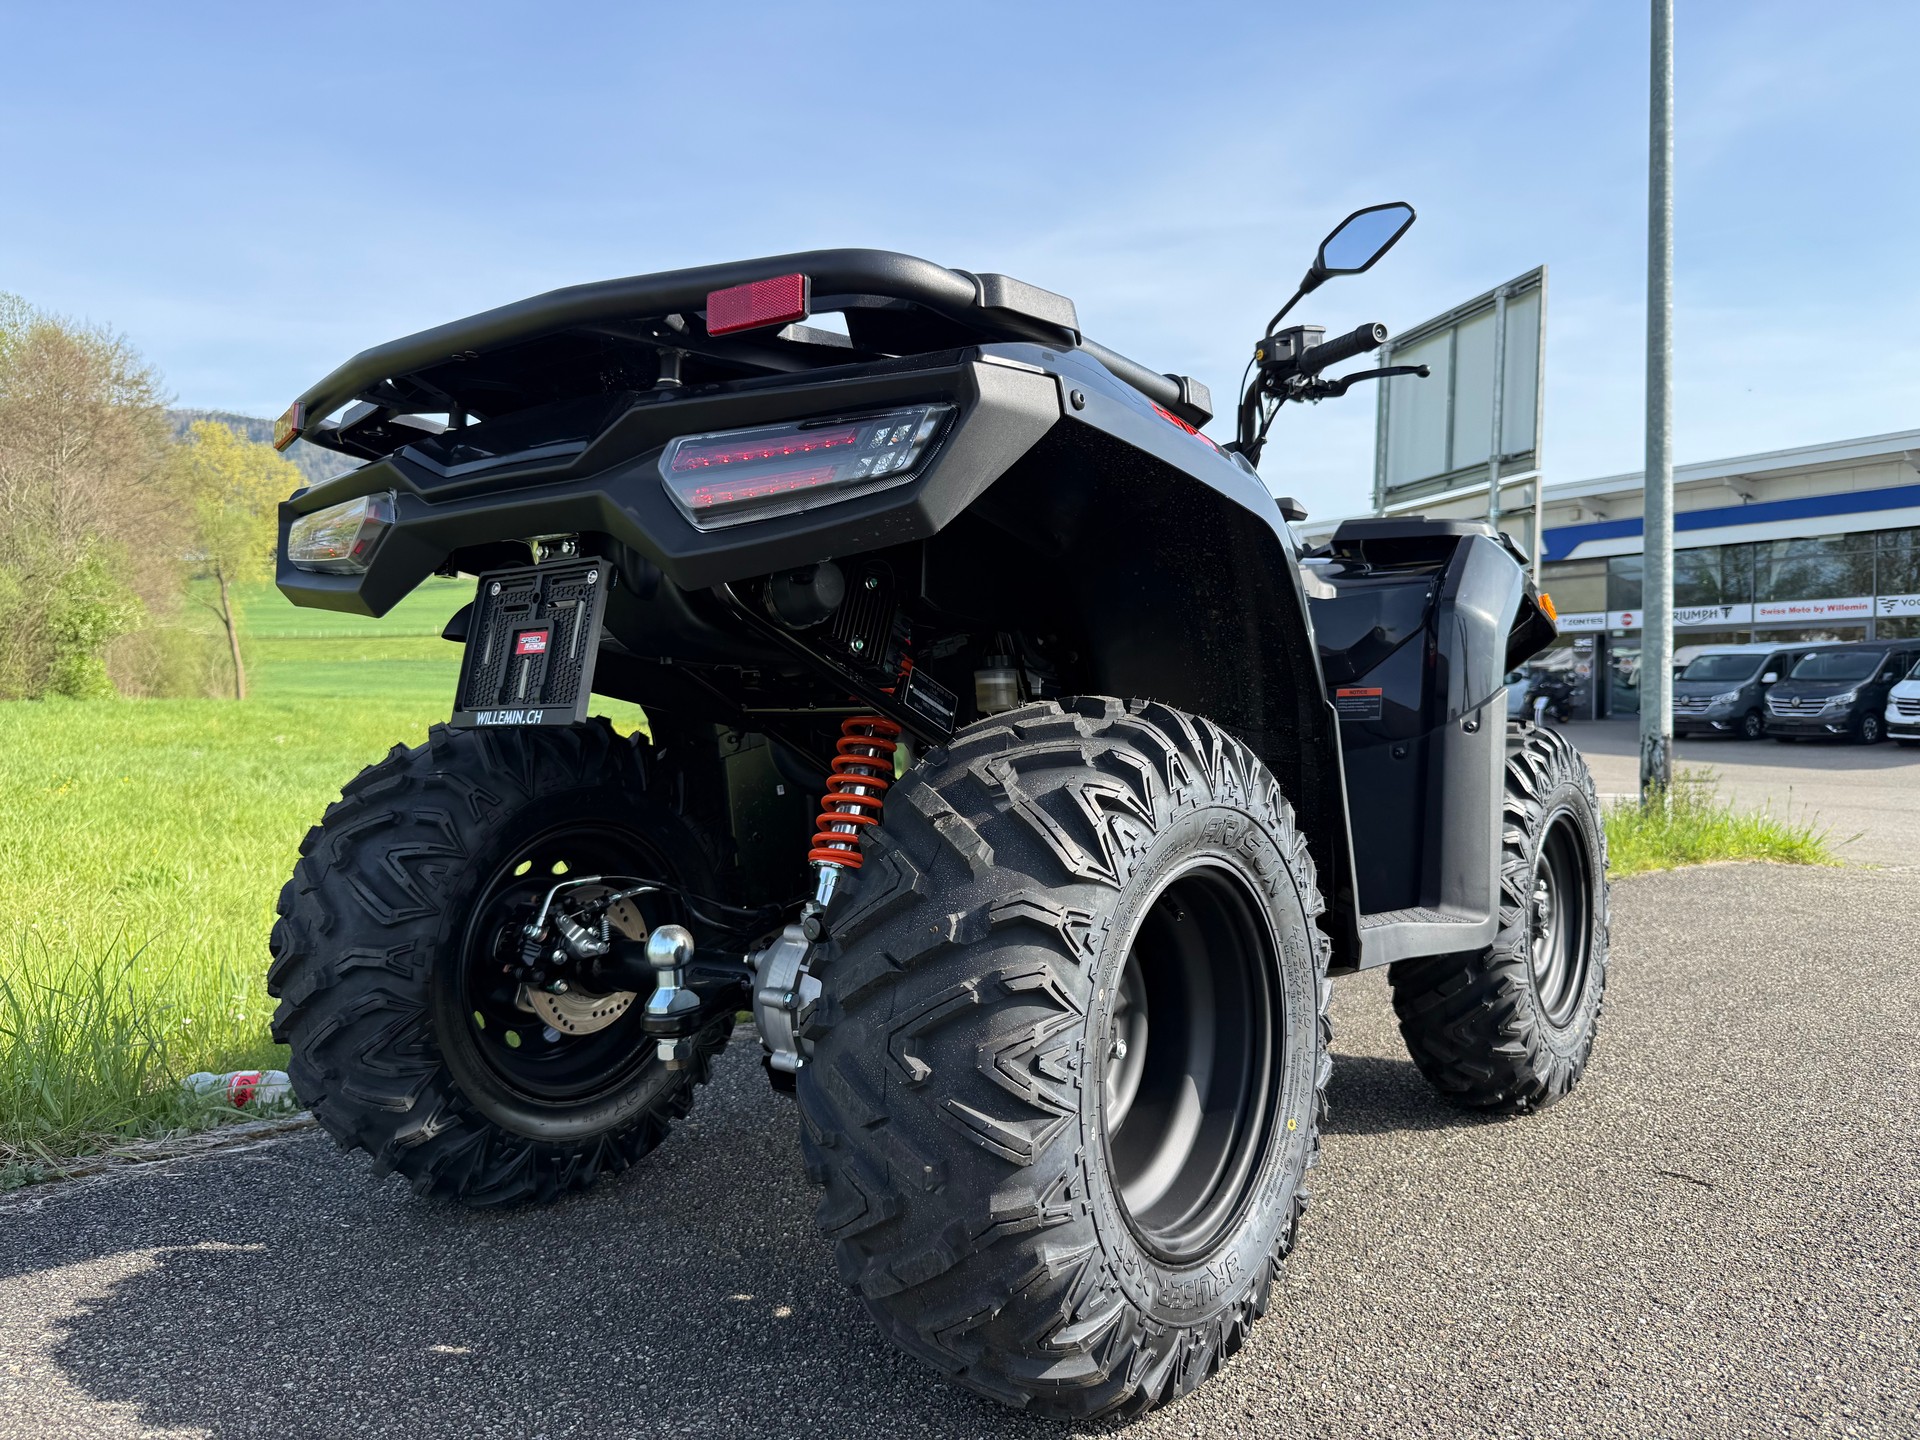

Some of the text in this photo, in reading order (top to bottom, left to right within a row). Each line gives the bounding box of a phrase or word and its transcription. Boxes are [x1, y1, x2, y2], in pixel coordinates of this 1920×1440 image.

[1672, 608, 1718, 622] RIUMPH
[1760, 603, 1868, 616] Swiss Moto by Willemin
[1567, 616, 1604, 626] ZONTES
[476, 710, 543, 725] WILLEMIN.CH
[1153, 1250, 1240, 1310] BRUISER
